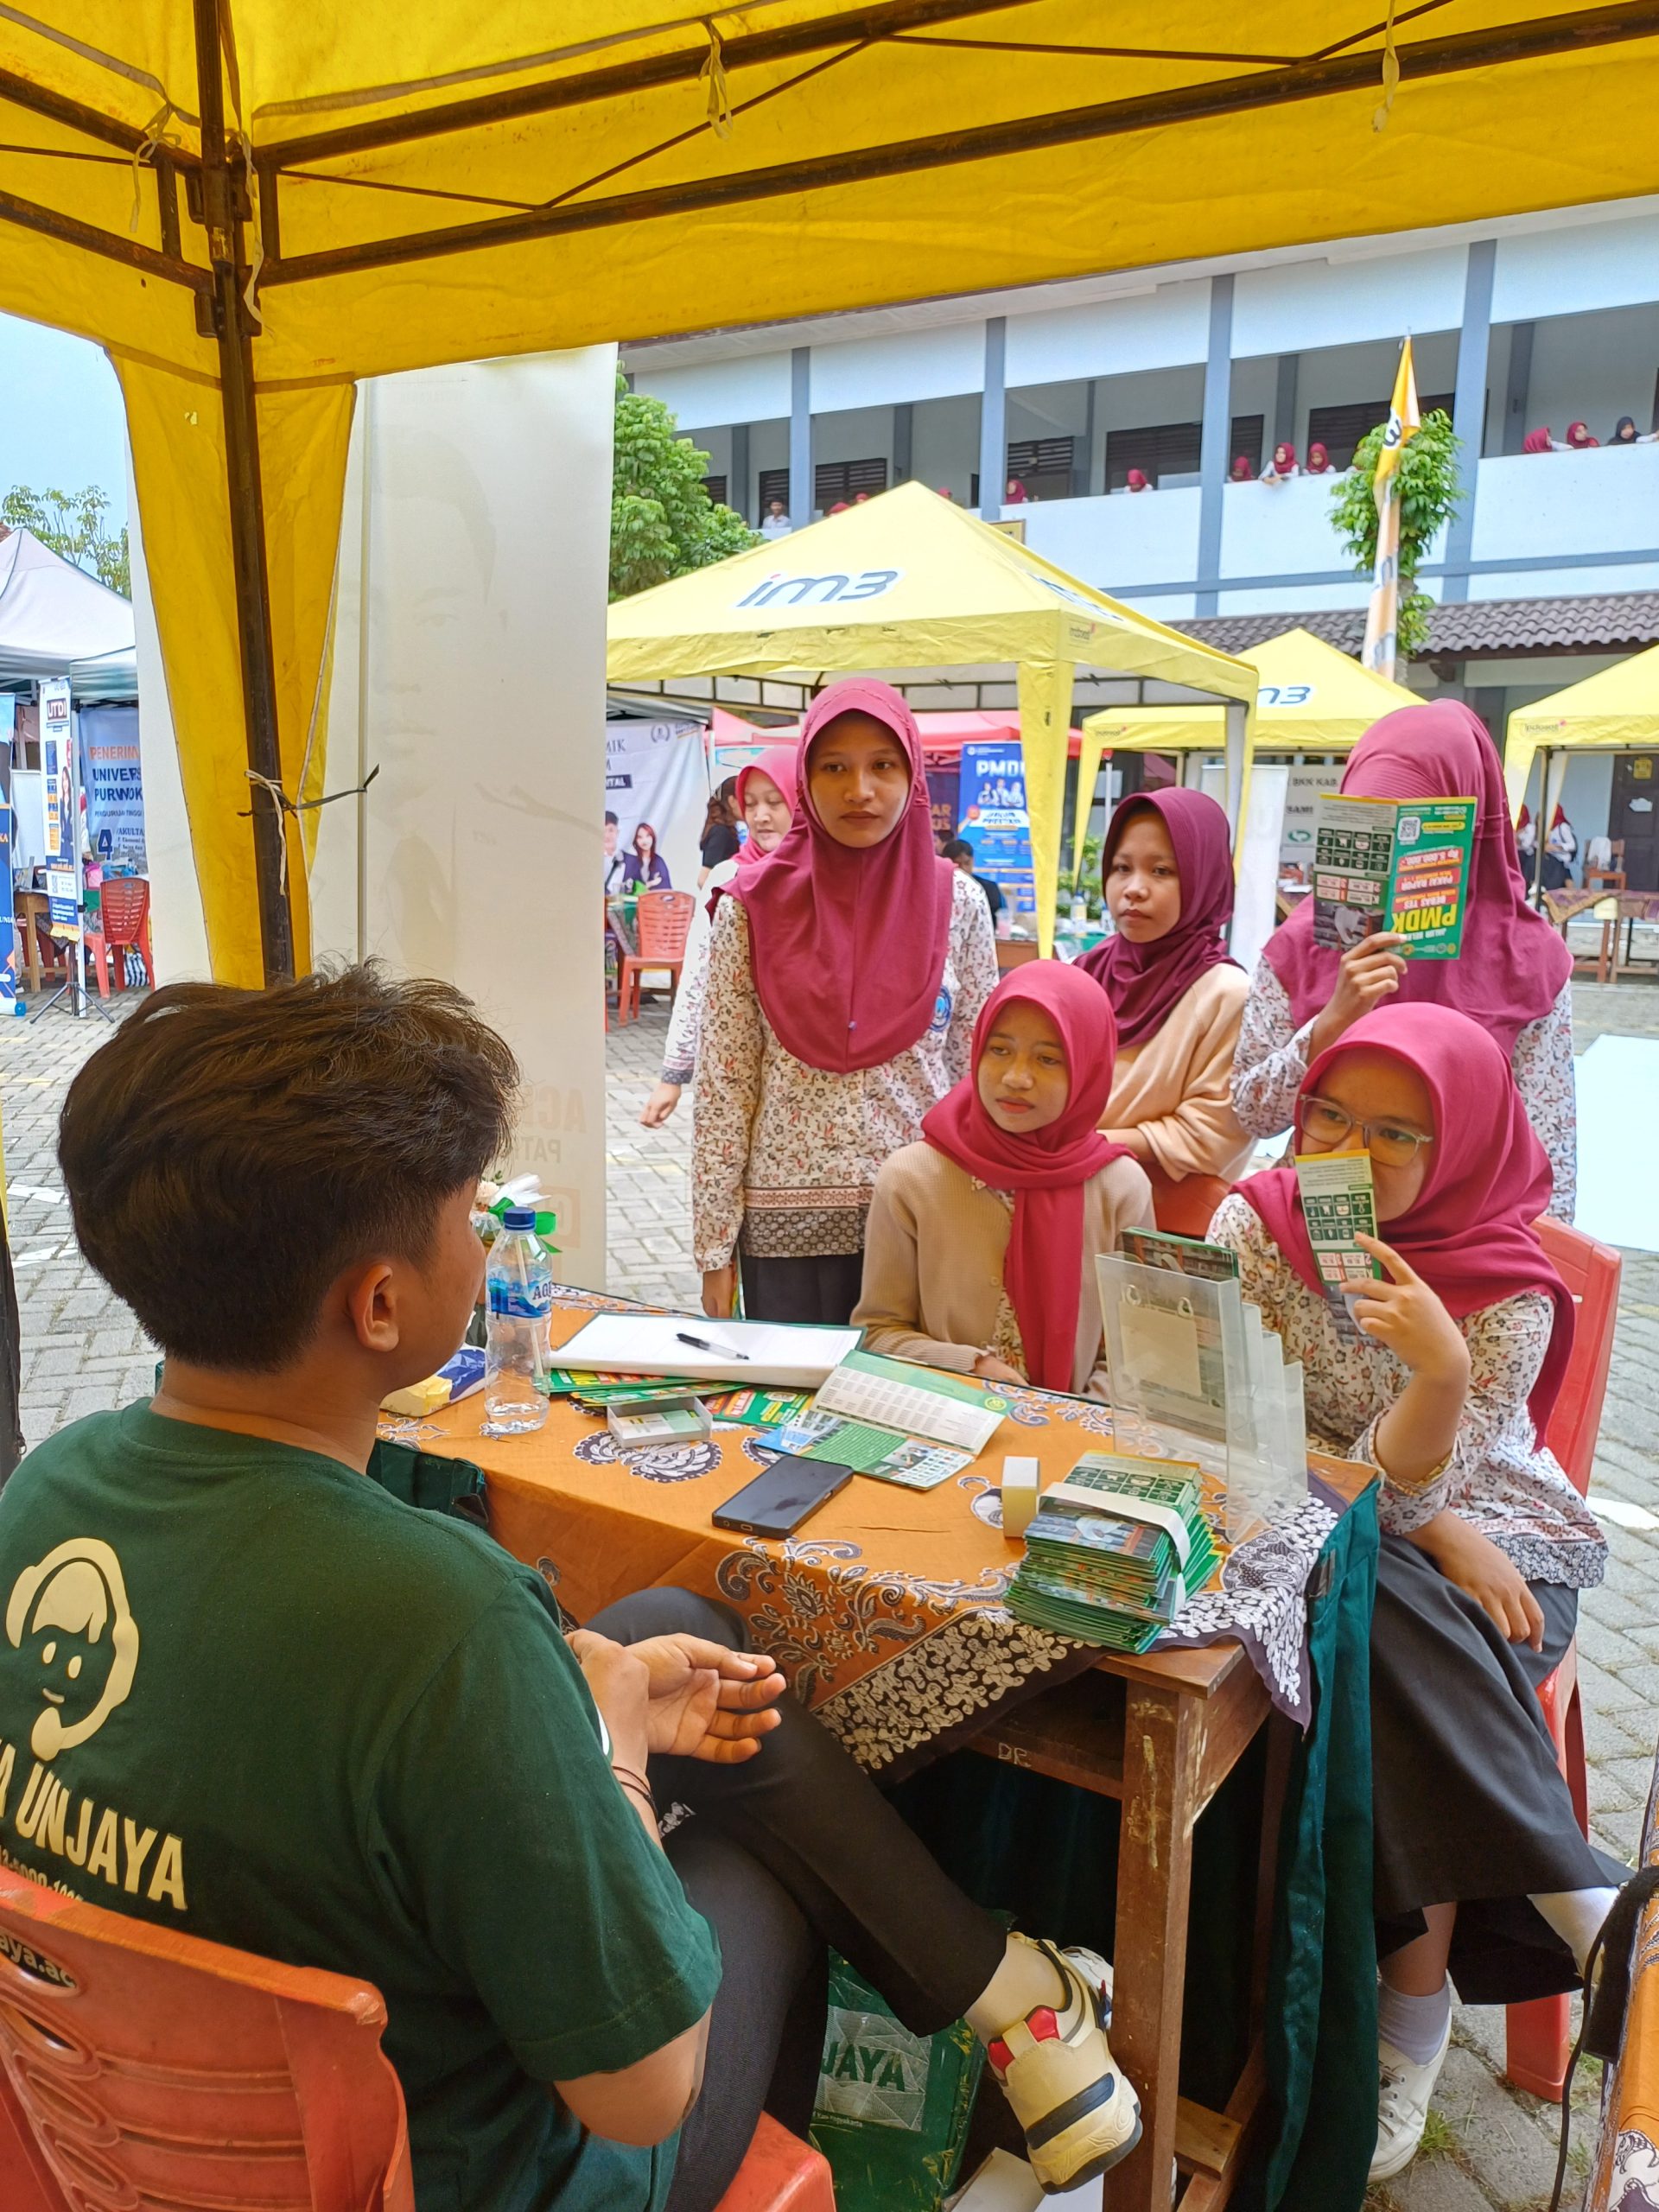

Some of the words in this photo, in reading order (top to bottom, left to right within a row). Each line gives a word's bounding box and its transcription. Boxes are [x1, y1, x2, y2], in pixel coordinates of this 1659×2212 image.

[736, 570, 899, 607] im3
[48, 700, 67, 718] UTDI
[94, 787, 143, 802] PURWOK
[99, 830, 112, 860] 4
[1390, 903, 1458, 934] PMDK
[15, 1760, 188, 1911] UNJAYA
[820, 2041, 906, 2092] JAYA
